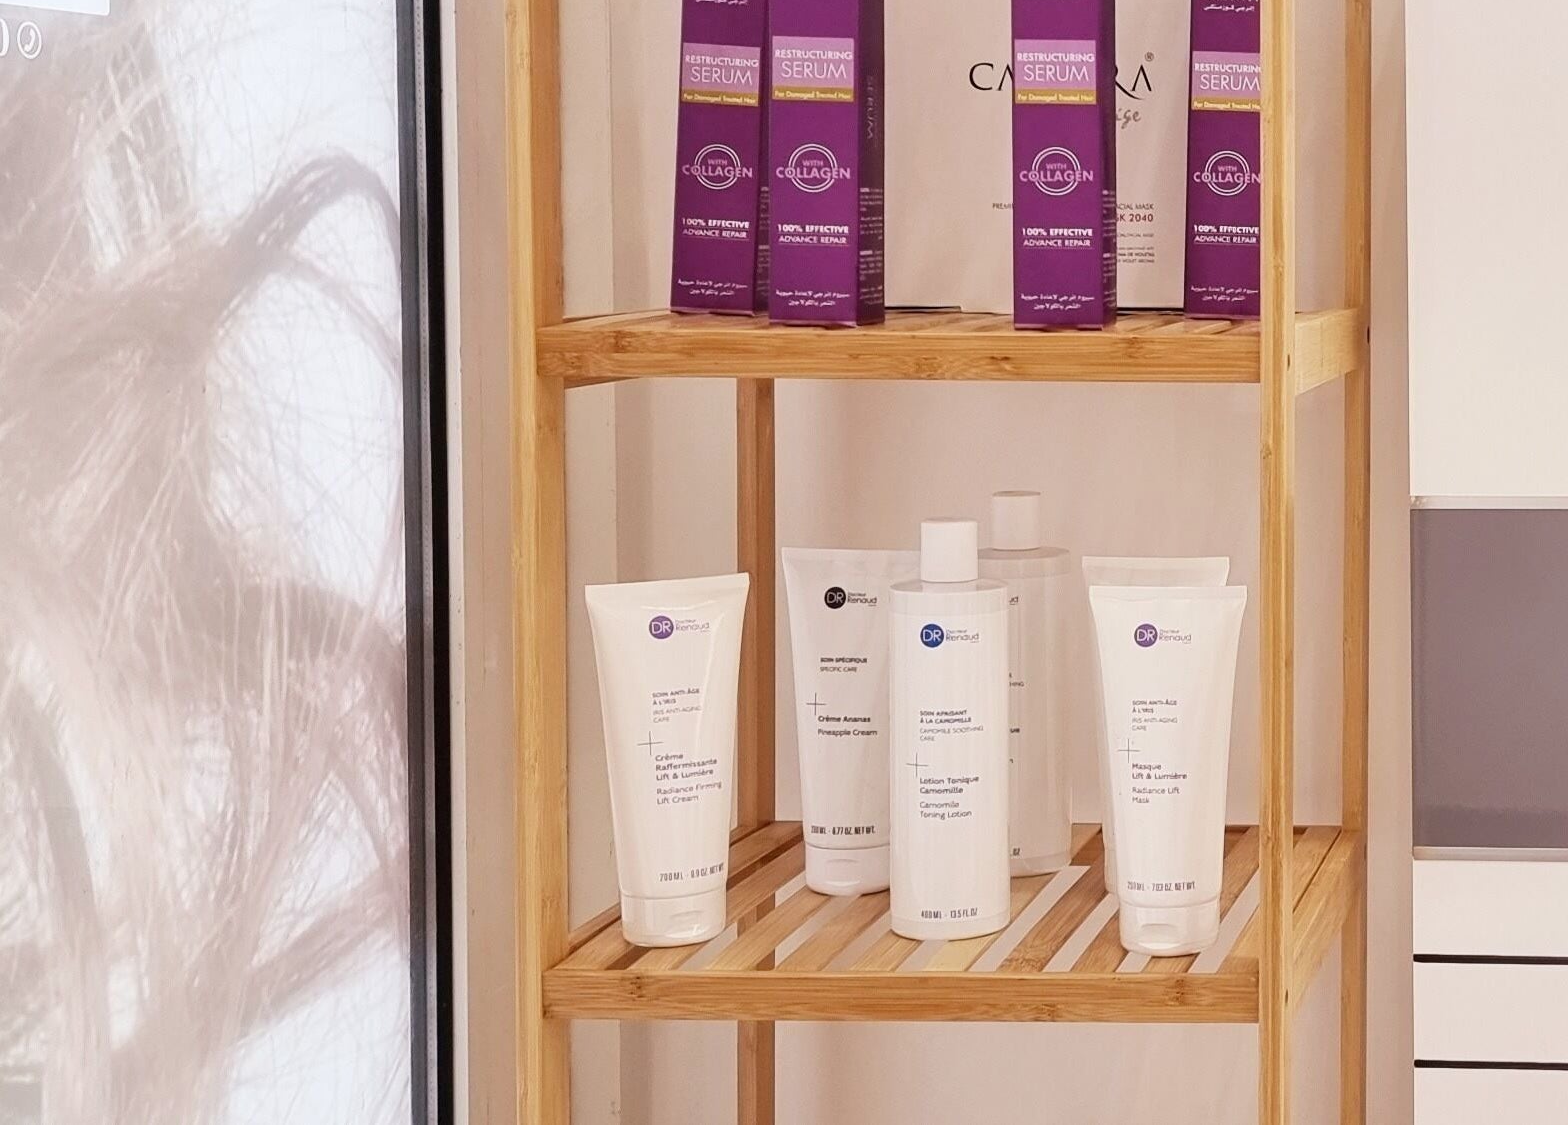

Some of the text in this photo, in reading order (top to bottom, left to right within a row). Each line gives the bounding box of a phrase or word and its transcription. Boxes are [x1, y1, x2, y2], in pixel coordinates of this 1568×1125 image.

[774, 49, 853, 60] RESTRUCTURING
[1017, 52, 1096, 63] RESTRUCTURING
[685, 54, 759, 68] RESTRUCTURING
[781, 60, 847, 79] SERUM
[1023, 63, 1089, 82] SERUM
[690, 66, 753, 86] SERUM
[1199, 74, 1261, 91] SERUM
[707, 158, 728, 166] WITH
[682, 164, 753, 178] COLLAGEN
[775, 166, 851, 179] COLLAGEN
[1019, 170, 1094, 182] COLLAGEN
[1193, 172, 1261, 184] COLLAGEN
[682, 217, 750, 229] 100% EFFECTIVE
[1129, 213, 1154, 223] 2040
[682, 228, 747, 238] ADVANCE REPAIR
[777, 223, 849, 234] 100% EFFECTIVE
[1021, 227, 1094, 237] 100% EFFECTIVE
[1193, 225, 1260, 234] 100% EFFECTIVE
[778, 235, 847, 244] ADVANCE REPAIR
[1023, 238, 1091, 247] ADVANCE REPAIR
[1193, 235, 1257, 244] ADVANCE REPAIR
[847, 595, 878, 604] Renaud
[675, 622, 710, 632] Renaud
[945, 633, 980, 642] Renaud
[1159, 634, 1192, 642] Renaud
[842, 715, 871, 723] Ananas
[817, 728, 851, 737] Pineapple
[656, 758, 718, 772] Raffermissante
[1132, 763, 1162, 772] Masque
[656, 768, 714, 781] Lift & Lumière
[1132, 772, 1144, 780] Lift
[920, 776, 980, 785] Lotion Tonique
[657, 785, 694, 795] Radiance
[919, 786, 964, 795] Camomille
[1132, 786, 1180, 794] Radiance Lift
[657, 795, 699, 805] Lift Cream
[919, 801, 960, 809] Camomile
[1132, 796, 1150, 804] Mask
[919, 810, 973, 821] Toning Lotion
